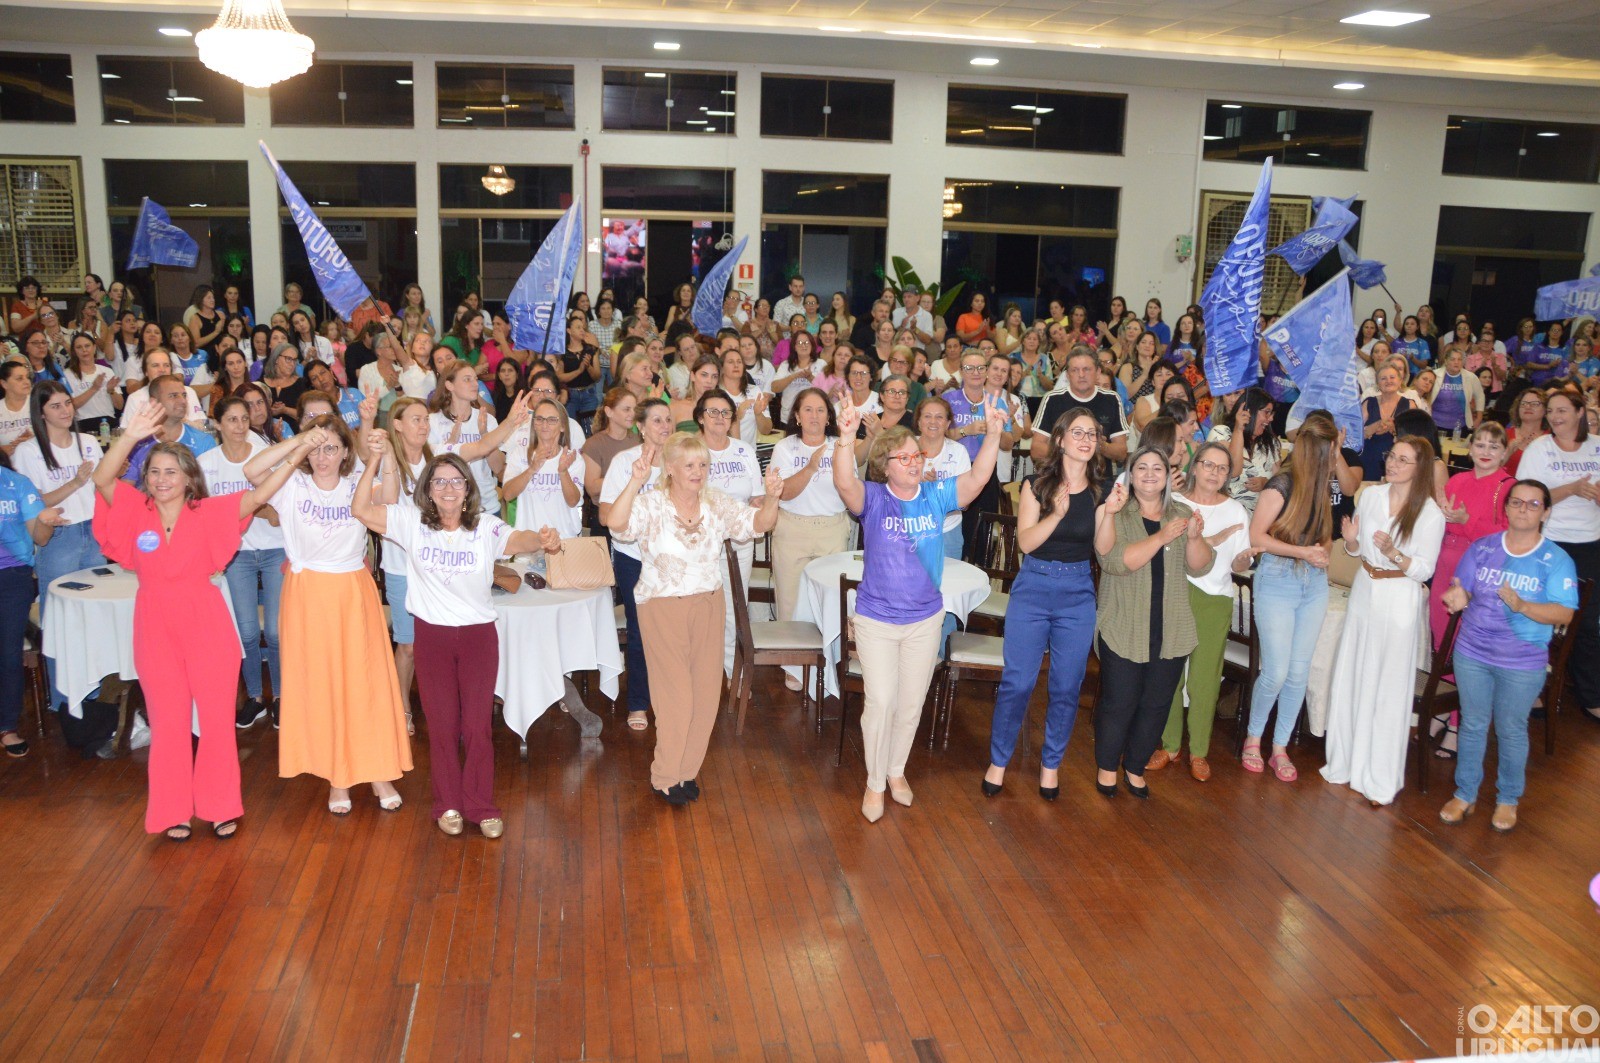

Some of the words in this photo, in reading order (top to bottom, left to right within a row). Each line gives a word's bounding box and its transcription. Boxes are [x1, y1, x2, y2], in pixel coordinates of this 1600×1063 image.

[1211, 335, 1232, 387] Mulheres
[303, 499, 312, 514] O
[885, 516, 893, 530] O
[421, 546, 430, 561] O
[431, 547, 474, 567] FUTURO
[1478, 567, 1488, 581] O
[1485, 568, 1540, 592] FUTURO
